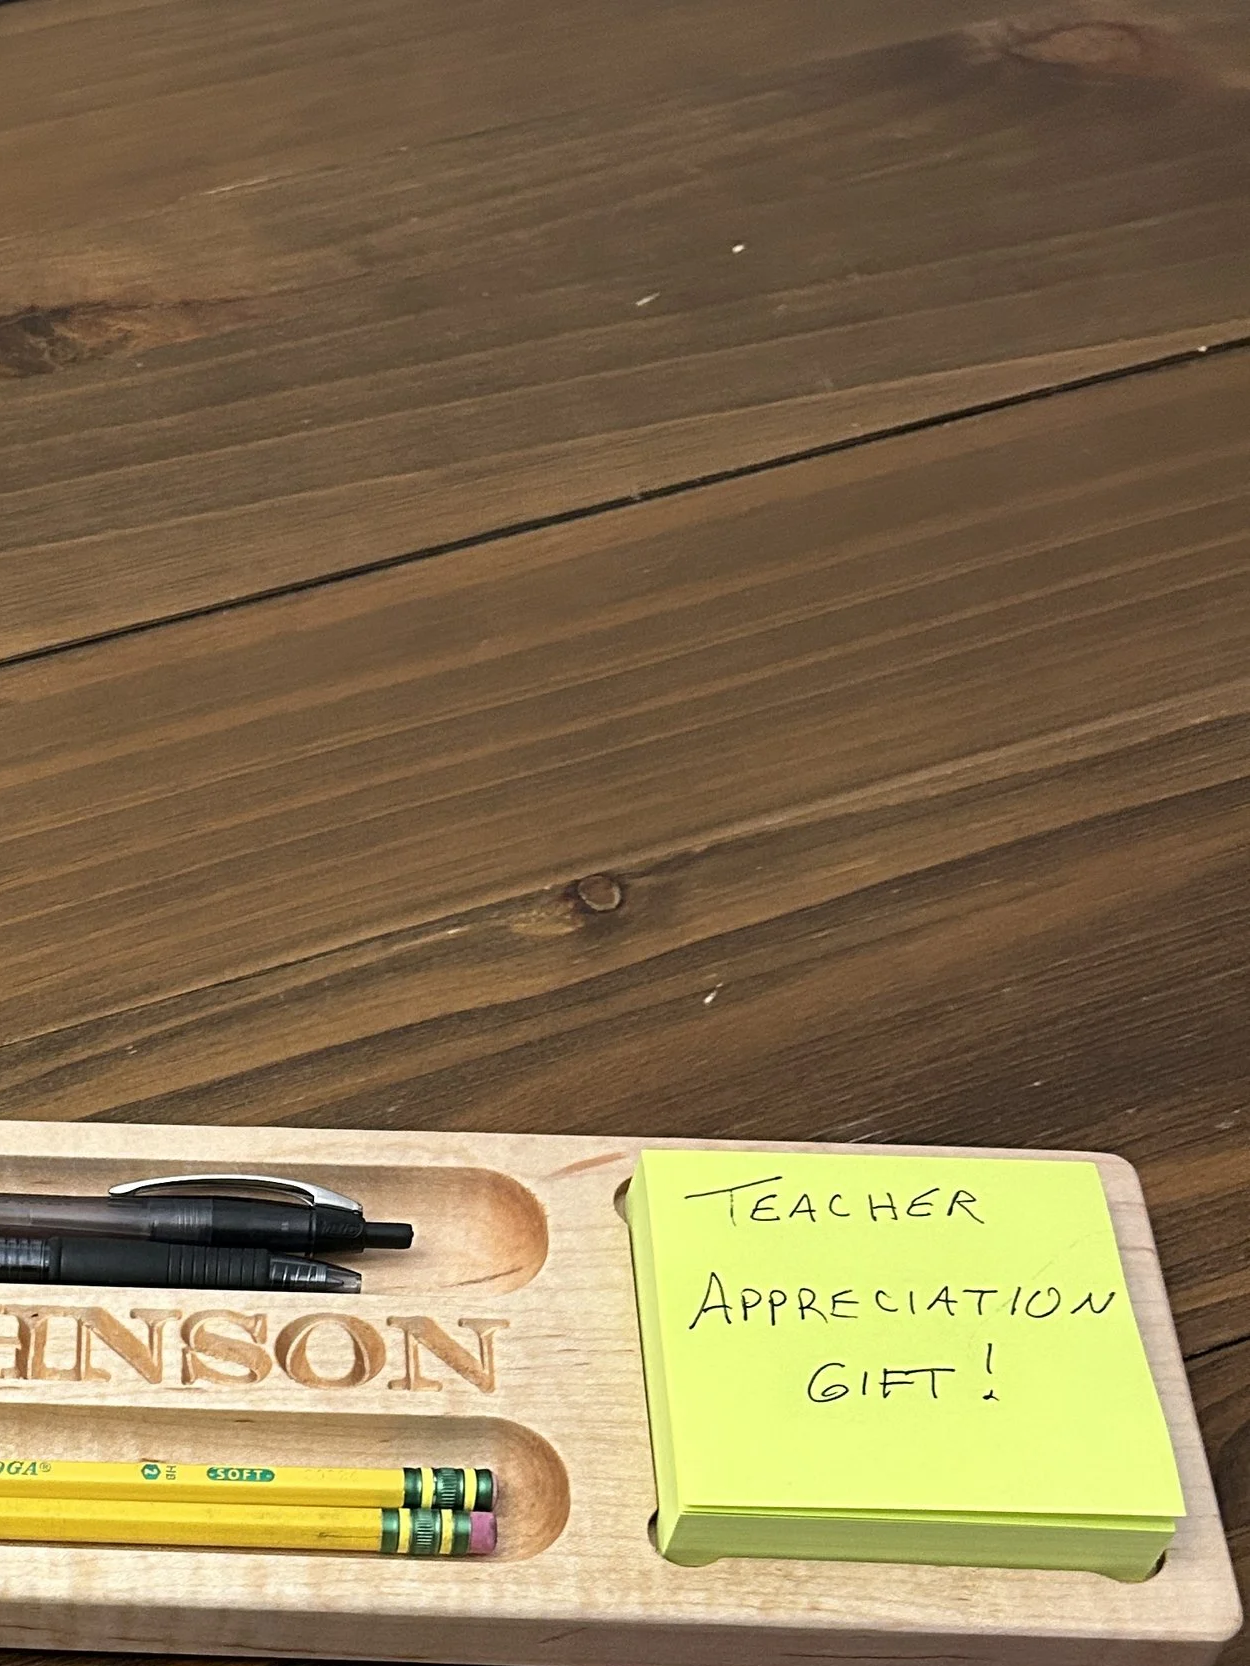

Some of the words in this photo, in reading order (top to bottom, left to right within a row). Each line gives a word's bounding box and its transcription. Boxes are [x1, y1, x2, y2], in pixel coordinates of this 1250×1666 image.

[684, 1175, 985, 1226] TEACHER
[688, 1271, 1117, 1330] APPRECIATION
[806, 1342, 1000, 1403] GIFT!
[165, 1465, 177, 1481] HB
[215, 1467, 264, 1481] SOFT
